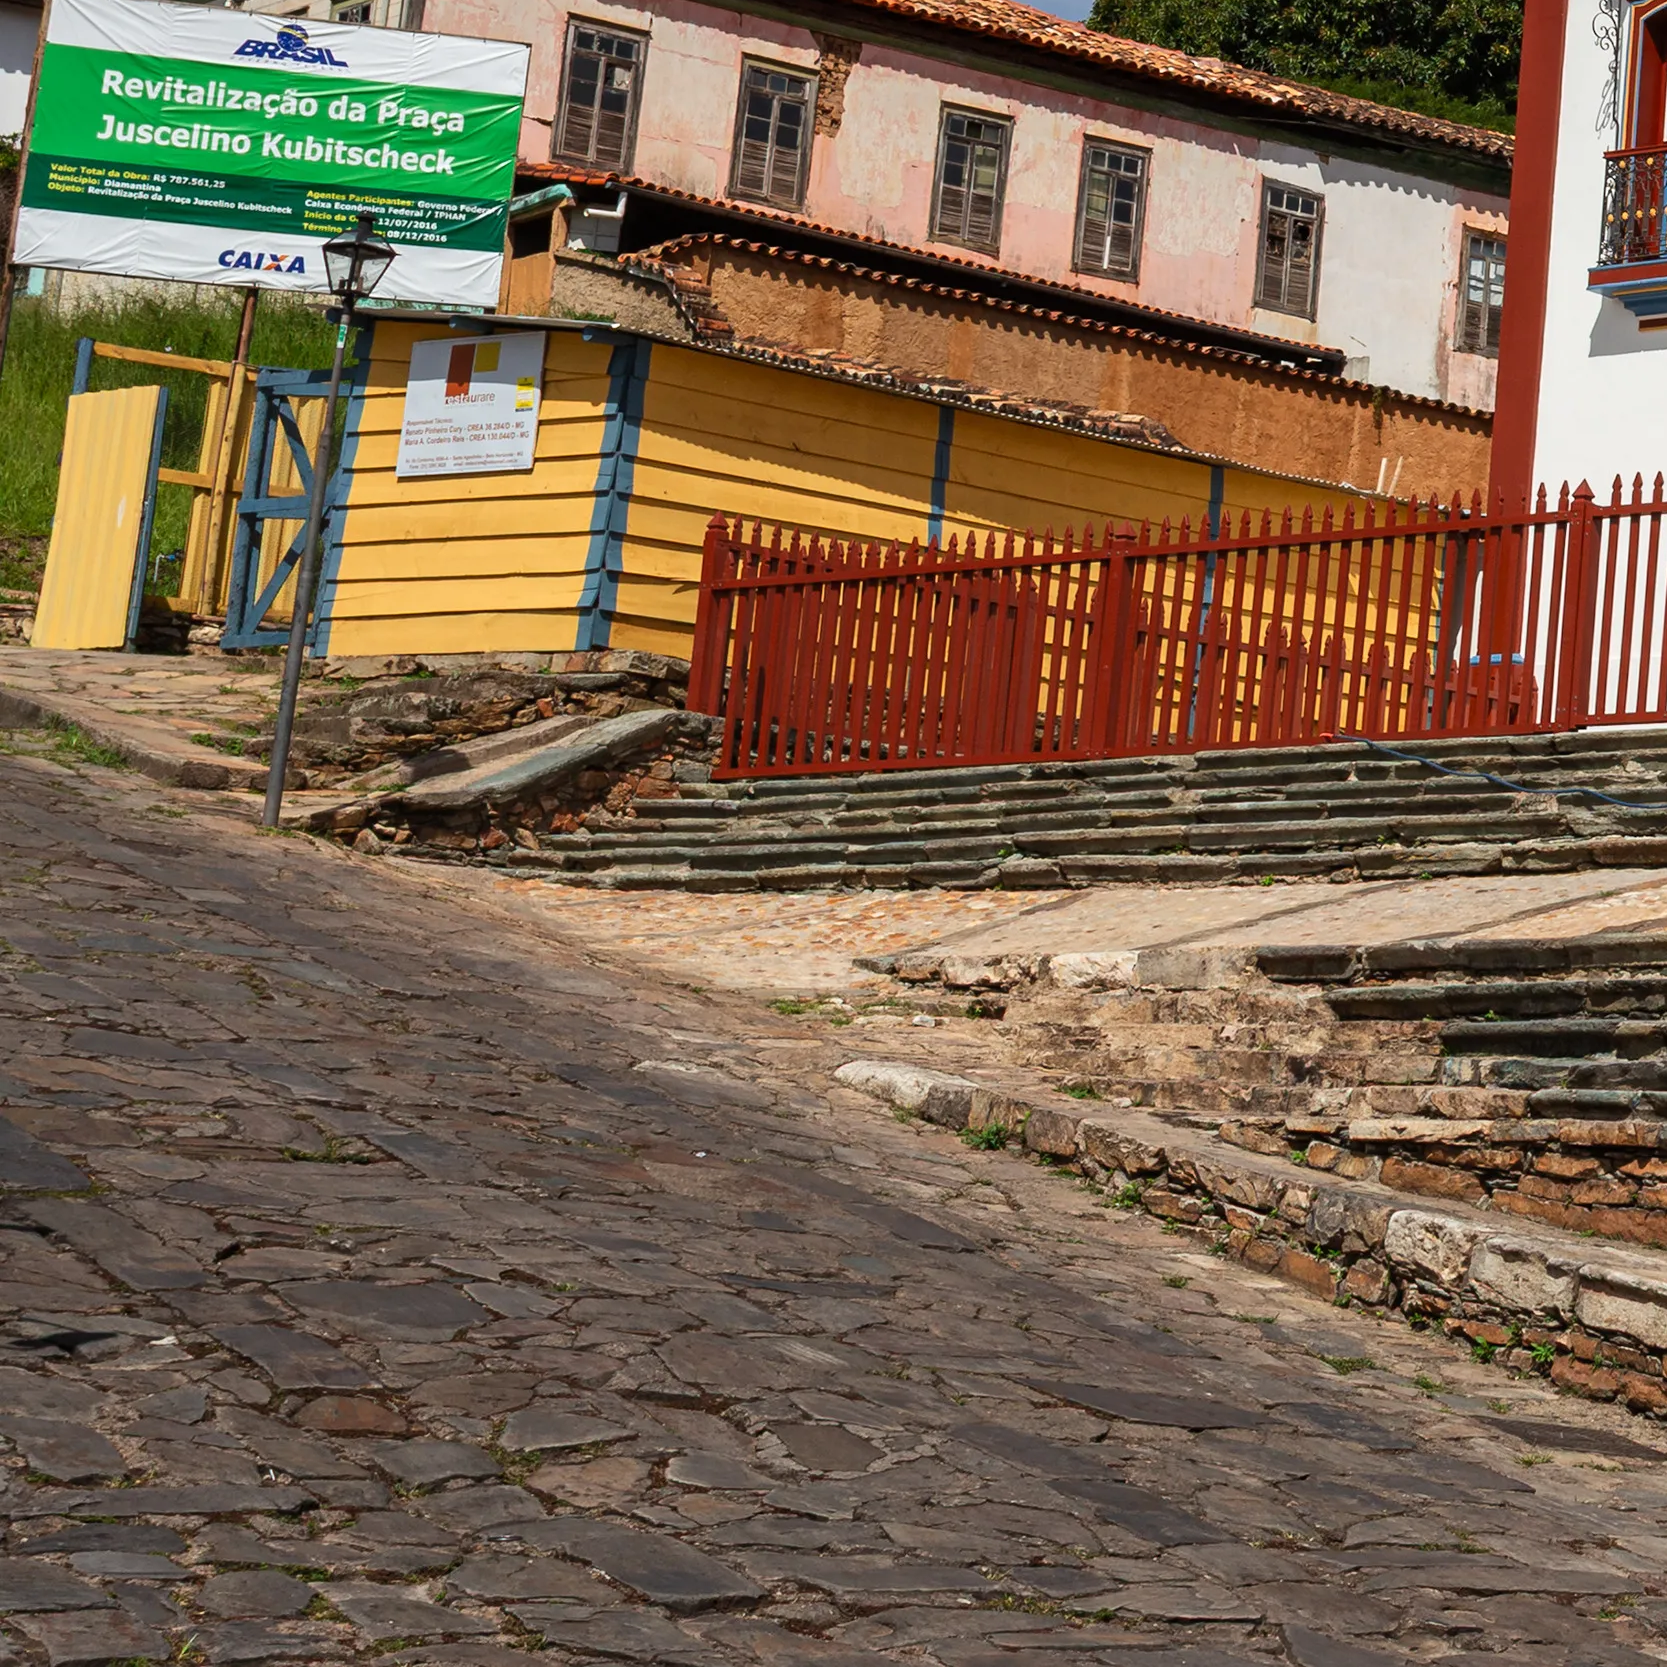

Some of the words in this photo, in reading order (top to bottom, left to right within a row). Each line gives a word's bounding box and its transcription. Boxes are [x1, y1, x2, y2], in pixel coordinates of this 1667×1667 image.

[233, 38, 349, 68] BRASIL
[101, 69, 318, 119] Revitalização
[328, 95, 366, 122] da
[377, 99, 465, 136] Praça
[97, 114, 251, 154] Juscelino
[261, 132, 456, 174] Kubitscheck
[49, 173, 100, 185] Município:
[104, 179, 161, 192] Diamantina
[50, 163, 77, 173] Valor
[80, 166, 105, 176] Total
[107, 169, 120, 178] da
[123, 170, 150, 181] Obra:
[153, 173, 167, 184] R$
[169, 175, 226, 189] 787.561,25
[47, 182, 84, 194] Objeto:
[87, 186, 149, 201] Revitalização
[151, 191, 163, 201] da
[164, 193, 190, 206] Praça
[192, 196, 235, 209] Juscelino
[237, 201, 292, 215] Kubitscheck
[305, 199, 332, 210] Caixa
[334, 201, 385, 214] Econômica
[388, 207, 423, 217] Federal
[434, 212, 466, 221] IPHAN
[306, 190, 347, 203] Agentes
[348, 193, 414, 207] Participantes:
[417, 200, 457, 211] Governo
[302, 222, 342, 234] Término
[387, 231, 447, 243] 08/12/2016
[304, 210, 332, 220] Início
[335, 213, 347, 222] da
[378, 218, 438, 230] 12/07/2016
[218, 249, 306, 274] CAIXA
